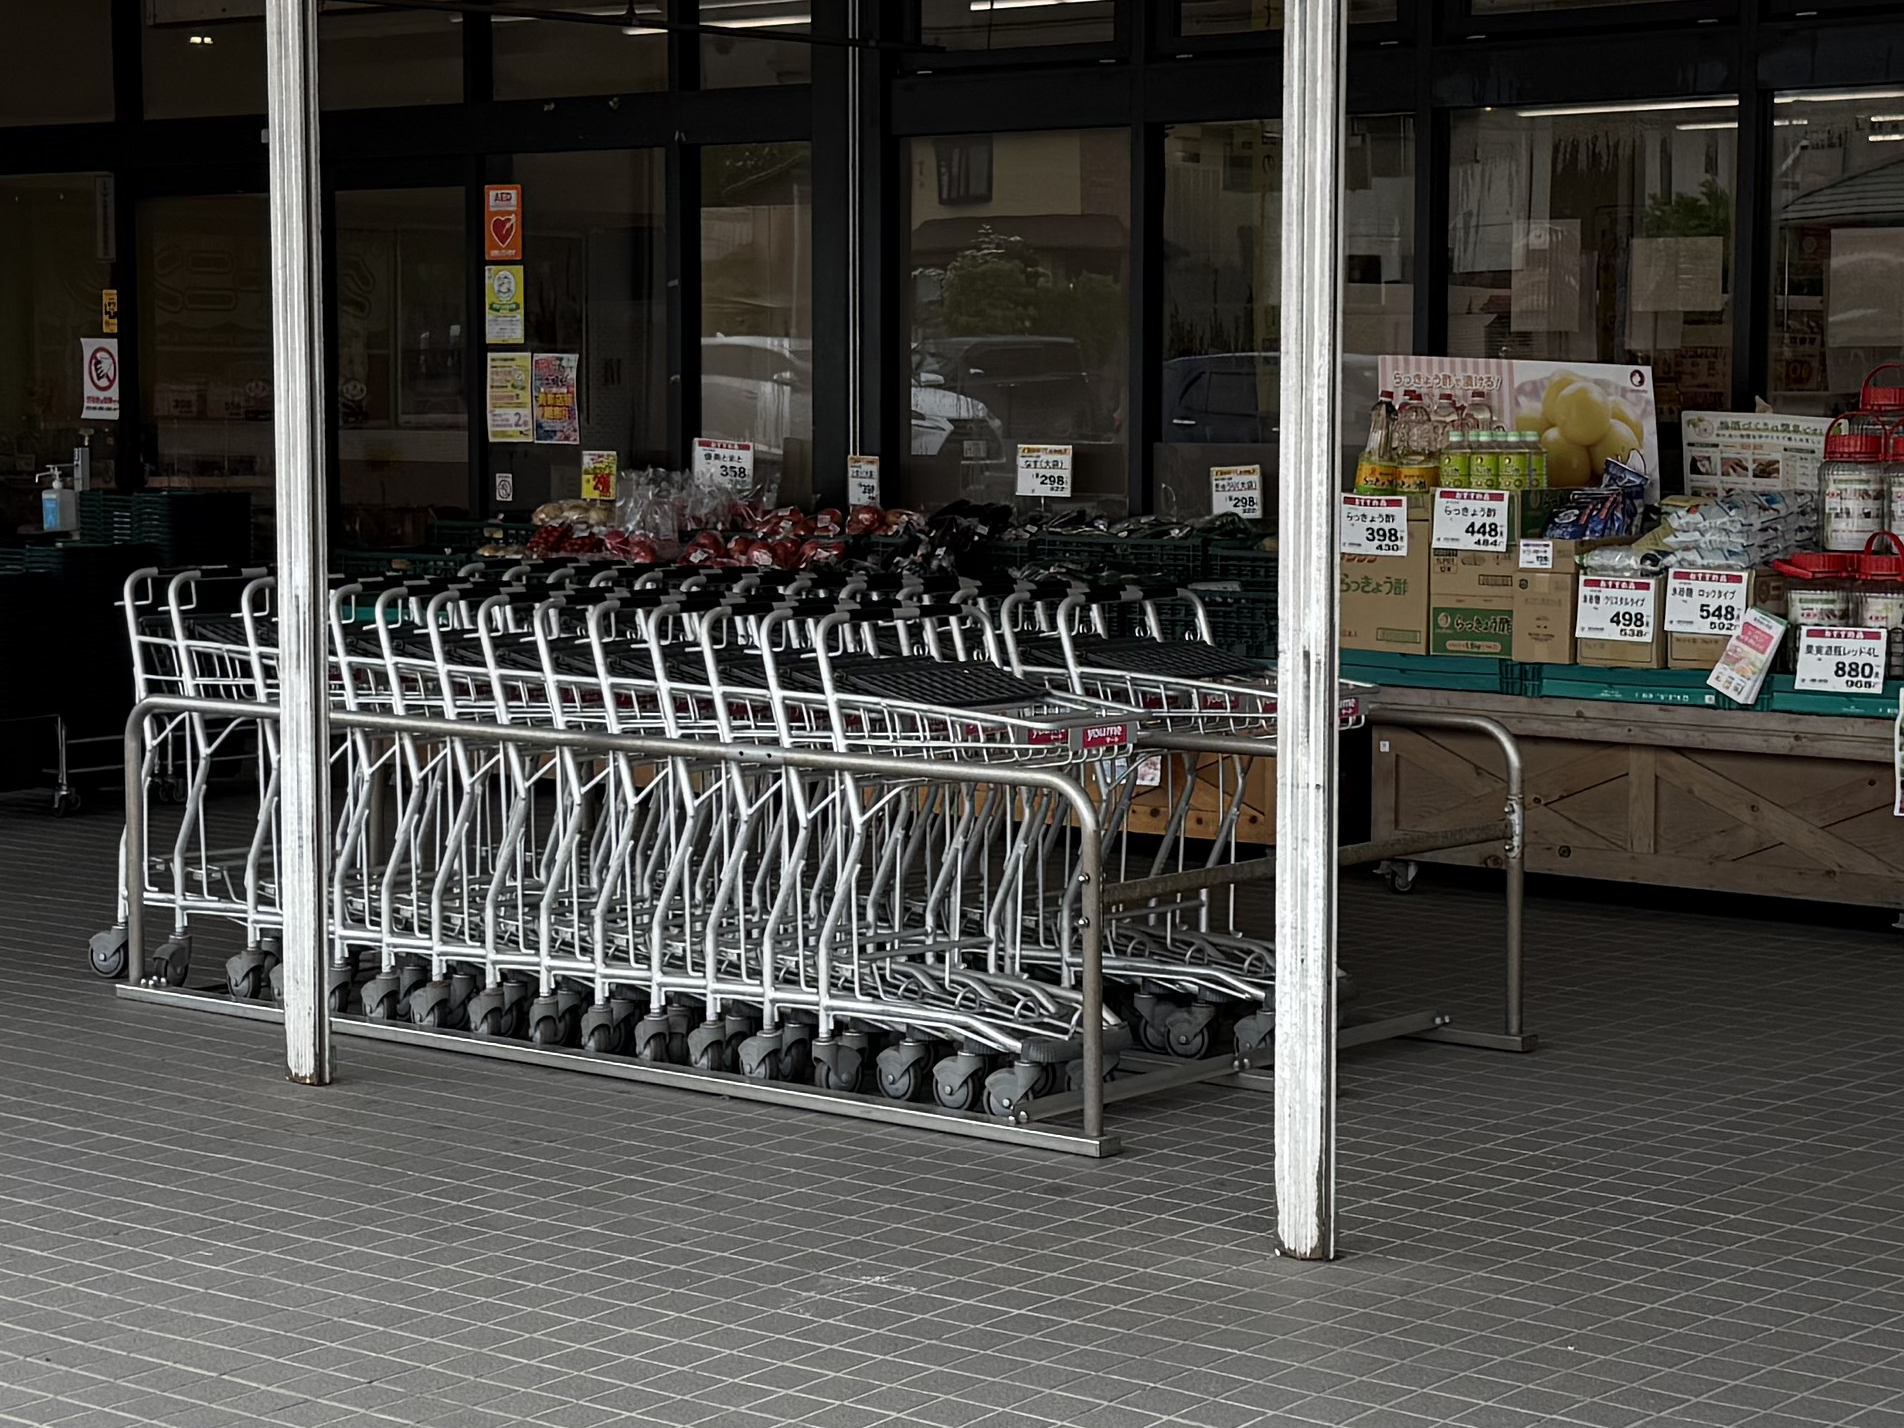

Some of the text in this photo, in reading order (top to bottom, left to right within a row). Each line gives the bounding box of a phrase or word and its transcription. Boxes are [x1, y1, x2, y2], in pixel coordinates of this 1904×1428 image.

[720, 464, 747, 479] 358
[1039, 474, 1065, 486] 298
[1232, 496, 1256, 509] 298
[1346, 512, 1396, 524] らっきょう酢
[1444, 505, 1497, 518] らっきょう酢
[1365, 526, 1400, 543] 398
[1465, 521, 1500, 538] 448
[1339, 573, 1409, 596] らっきょう酢
[1697, 588, 1736, 601] ロックタイプ
[1609, 610, 1645, 628] 498
[1699, 603, 1736, 622] 548
[1833, 661, 1875, 679] 880
[1087, 725, 1122, 742] youme
